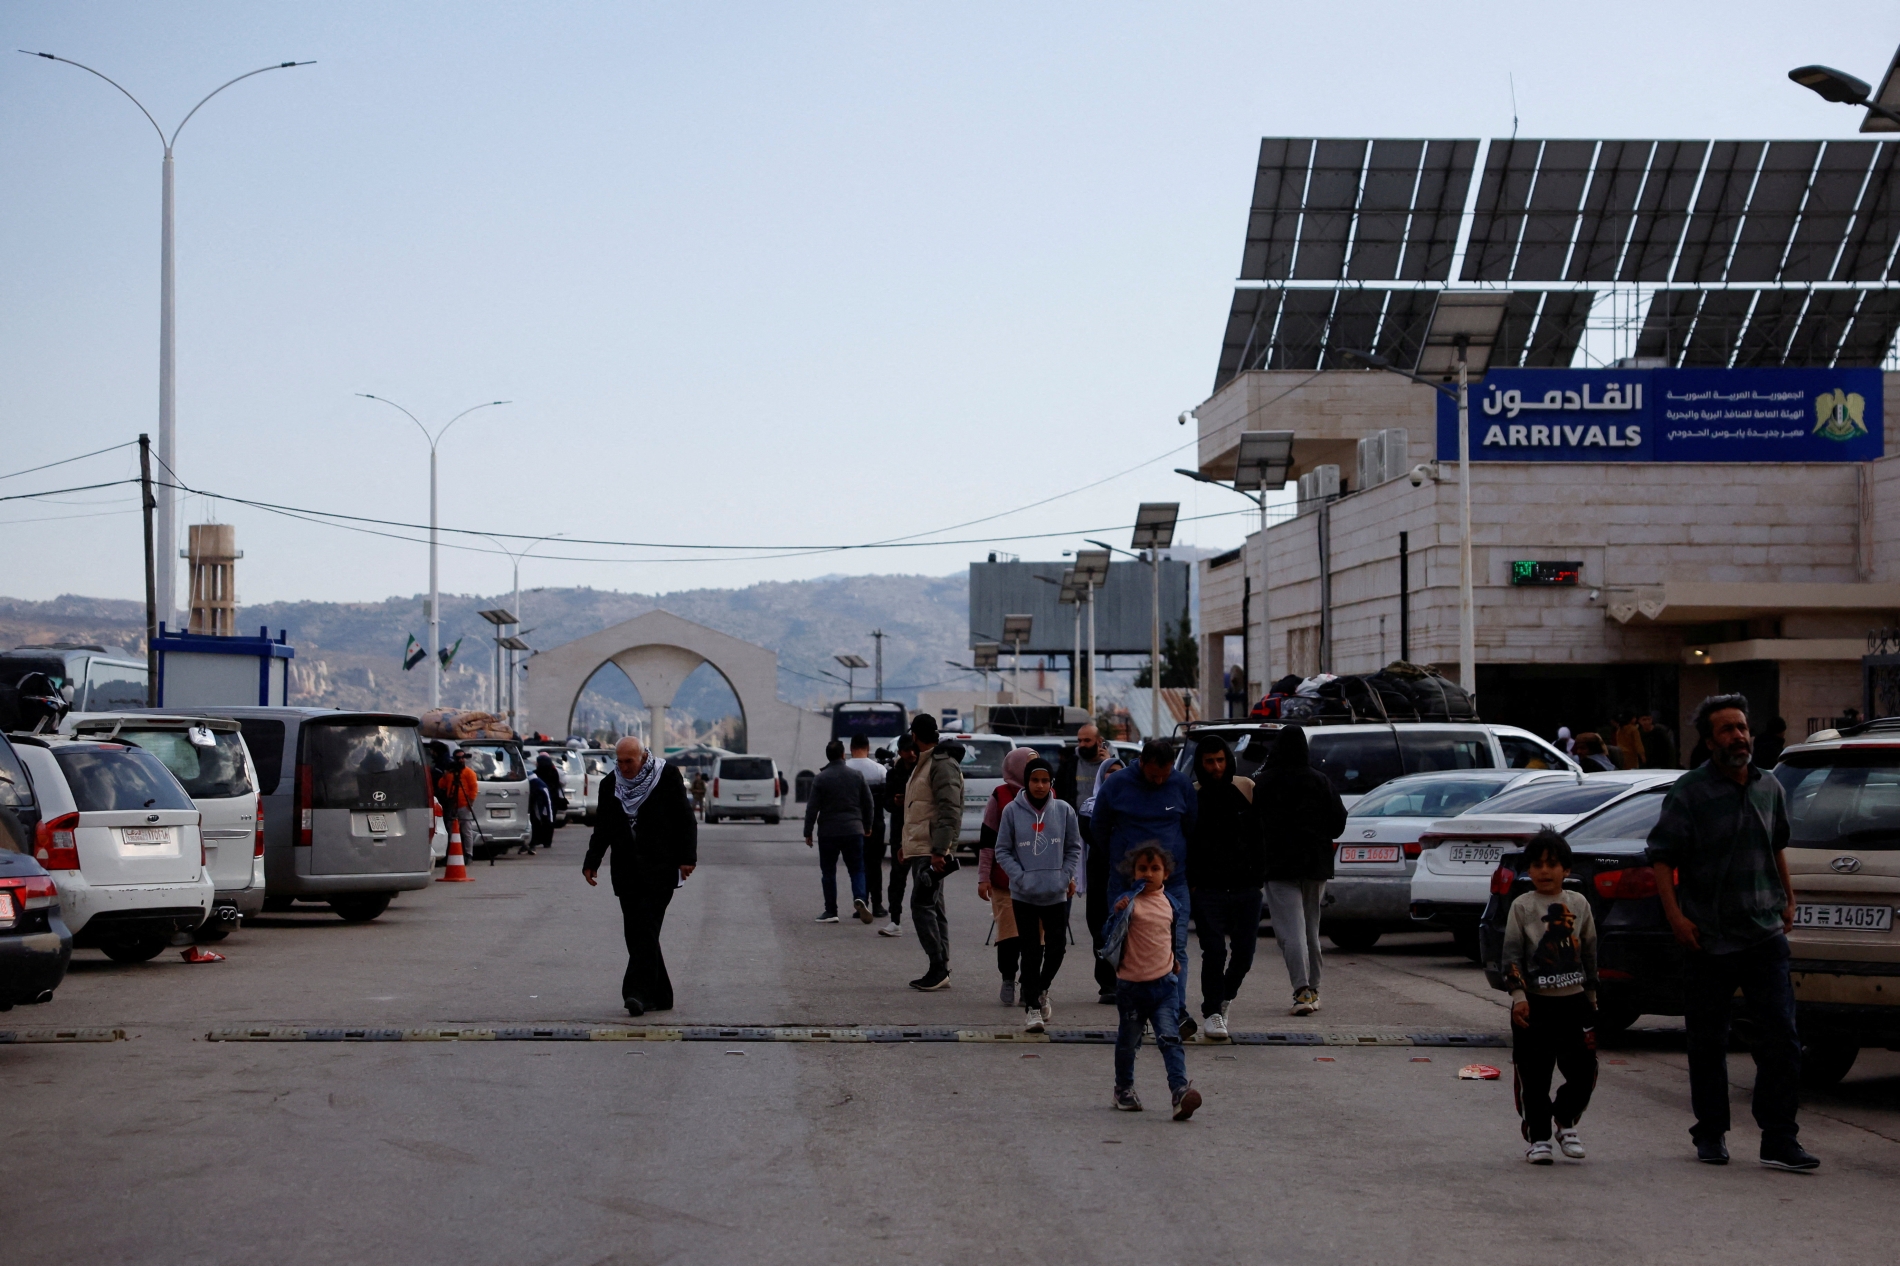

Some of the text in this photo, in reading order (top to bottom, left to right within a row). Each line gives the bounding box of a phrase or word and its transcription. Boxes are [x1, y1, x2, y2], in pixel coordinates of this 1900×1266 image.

[1483, 383, 1642, 418] القادمون
[1667, 390, 1711, 400] السورية
[1752, 390, 1804, 400] الجمهورية
[1700, 409, 1722, 420] البرية
[1724, 409, 1752, 419] للمنافذ
[1753, 409, 1779, 419] العامة
[1482, 425, 1642, 446] ARRIVALS
[1747, 429, 1779, 439] جديدة
[1345, 848, 1395, 859] 50 16637
[1453, 848, 1500, 860] 15 79695
[1794, 906, 1885, 926] 15 14057
